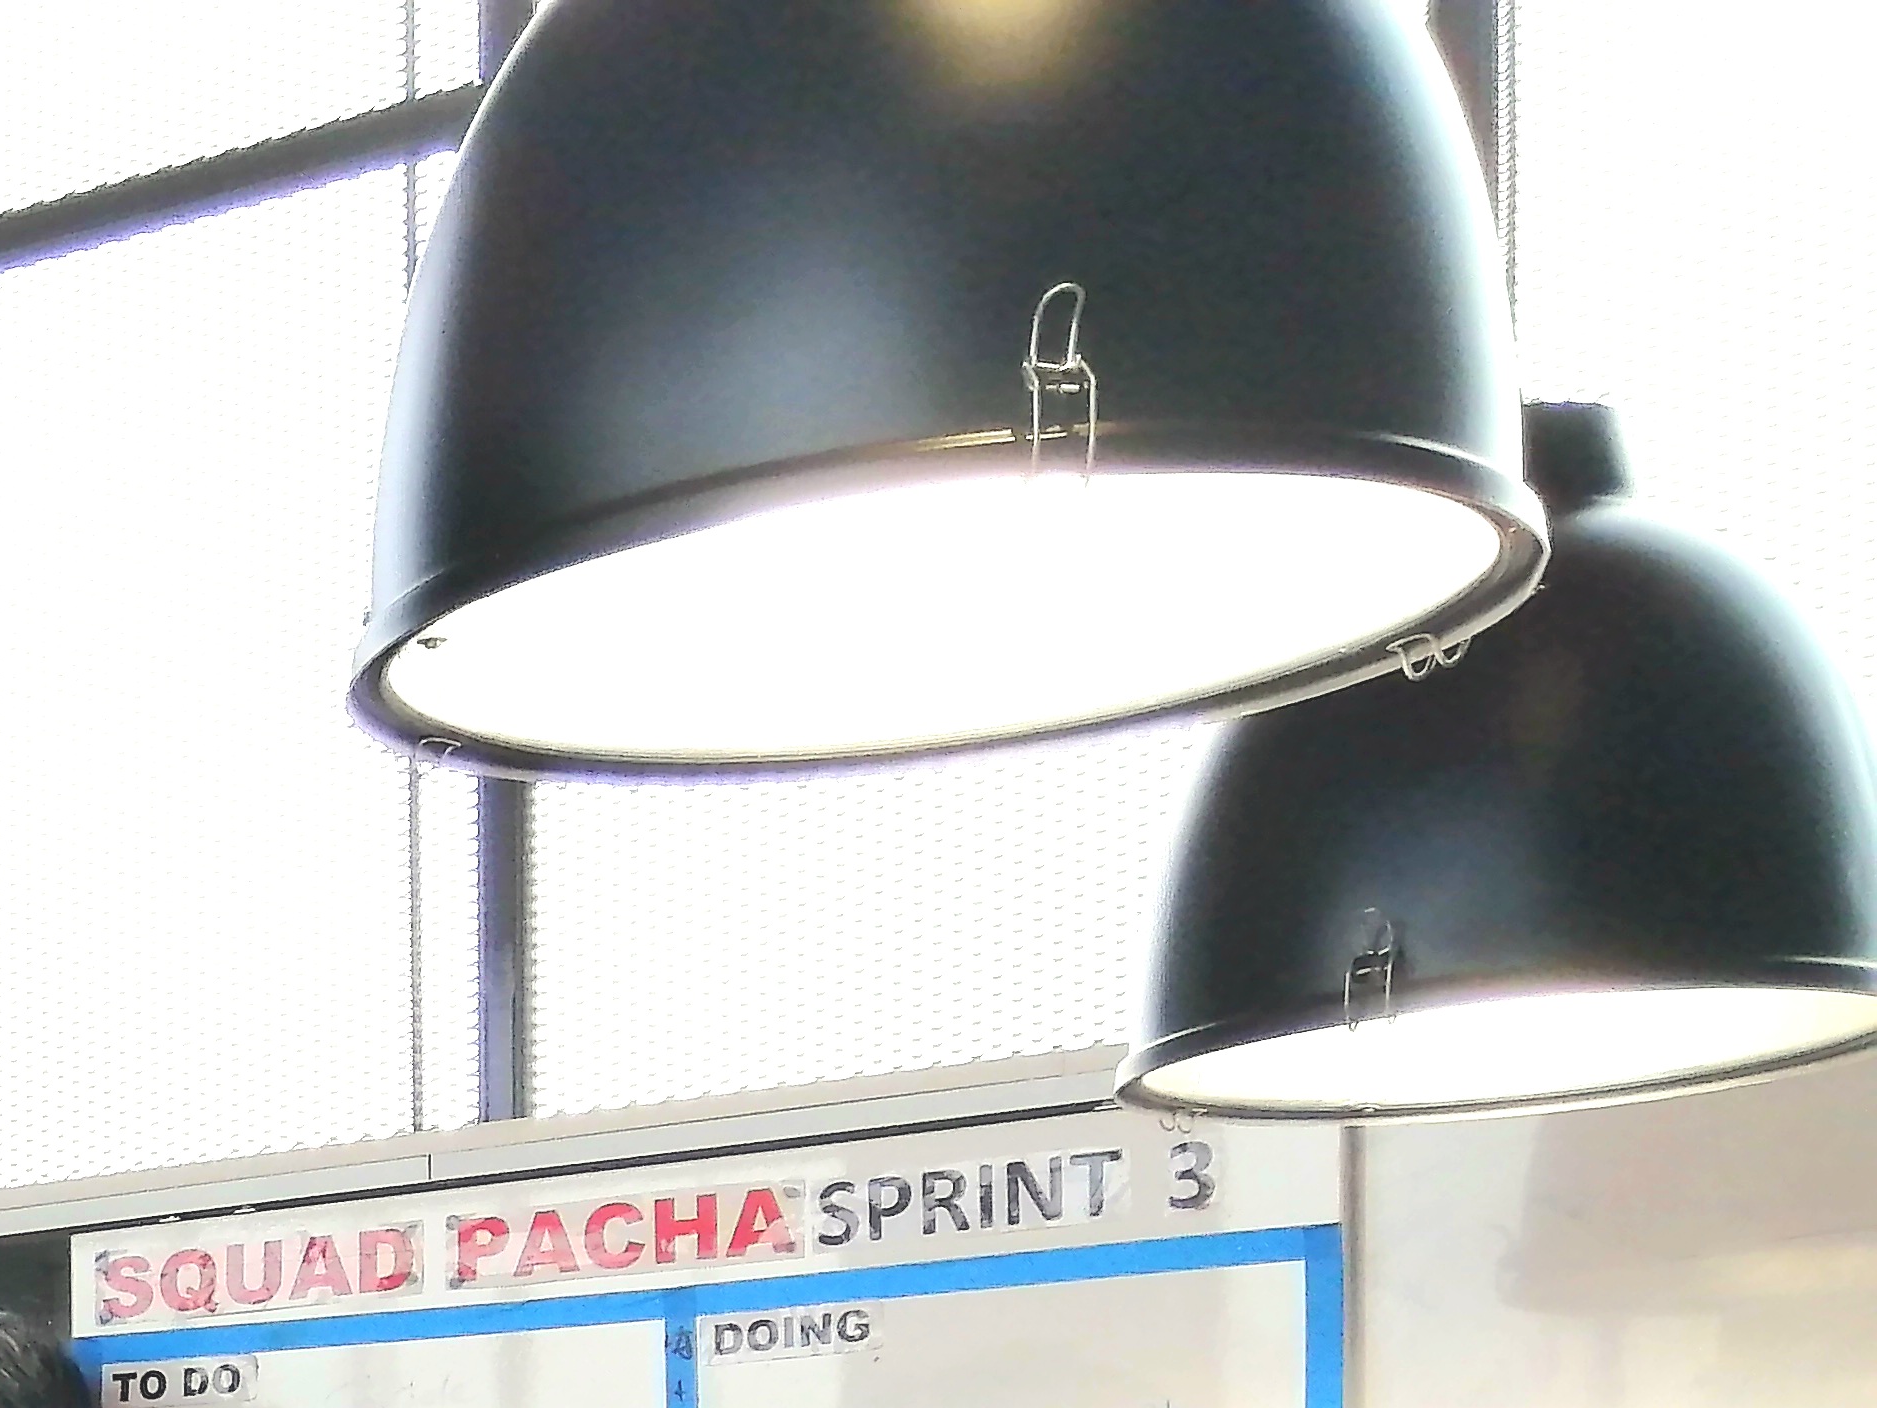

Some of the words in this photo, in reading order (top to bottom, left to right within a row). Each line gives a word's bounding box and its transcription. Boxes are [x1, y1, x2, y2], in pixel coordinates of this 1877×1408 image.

[103, 1227, 417, 1319] SQUAD
[455, 1187, 799, 1282] PACHA
[817, 1149, 1122, 1248] SPRINT
[1169, 1140, 1216, 1211] 3
[713, 1308, 871, 1356] DOING
[111, 1368, 167, 1402] TO
[183, 1363, 241, 1398] DO
